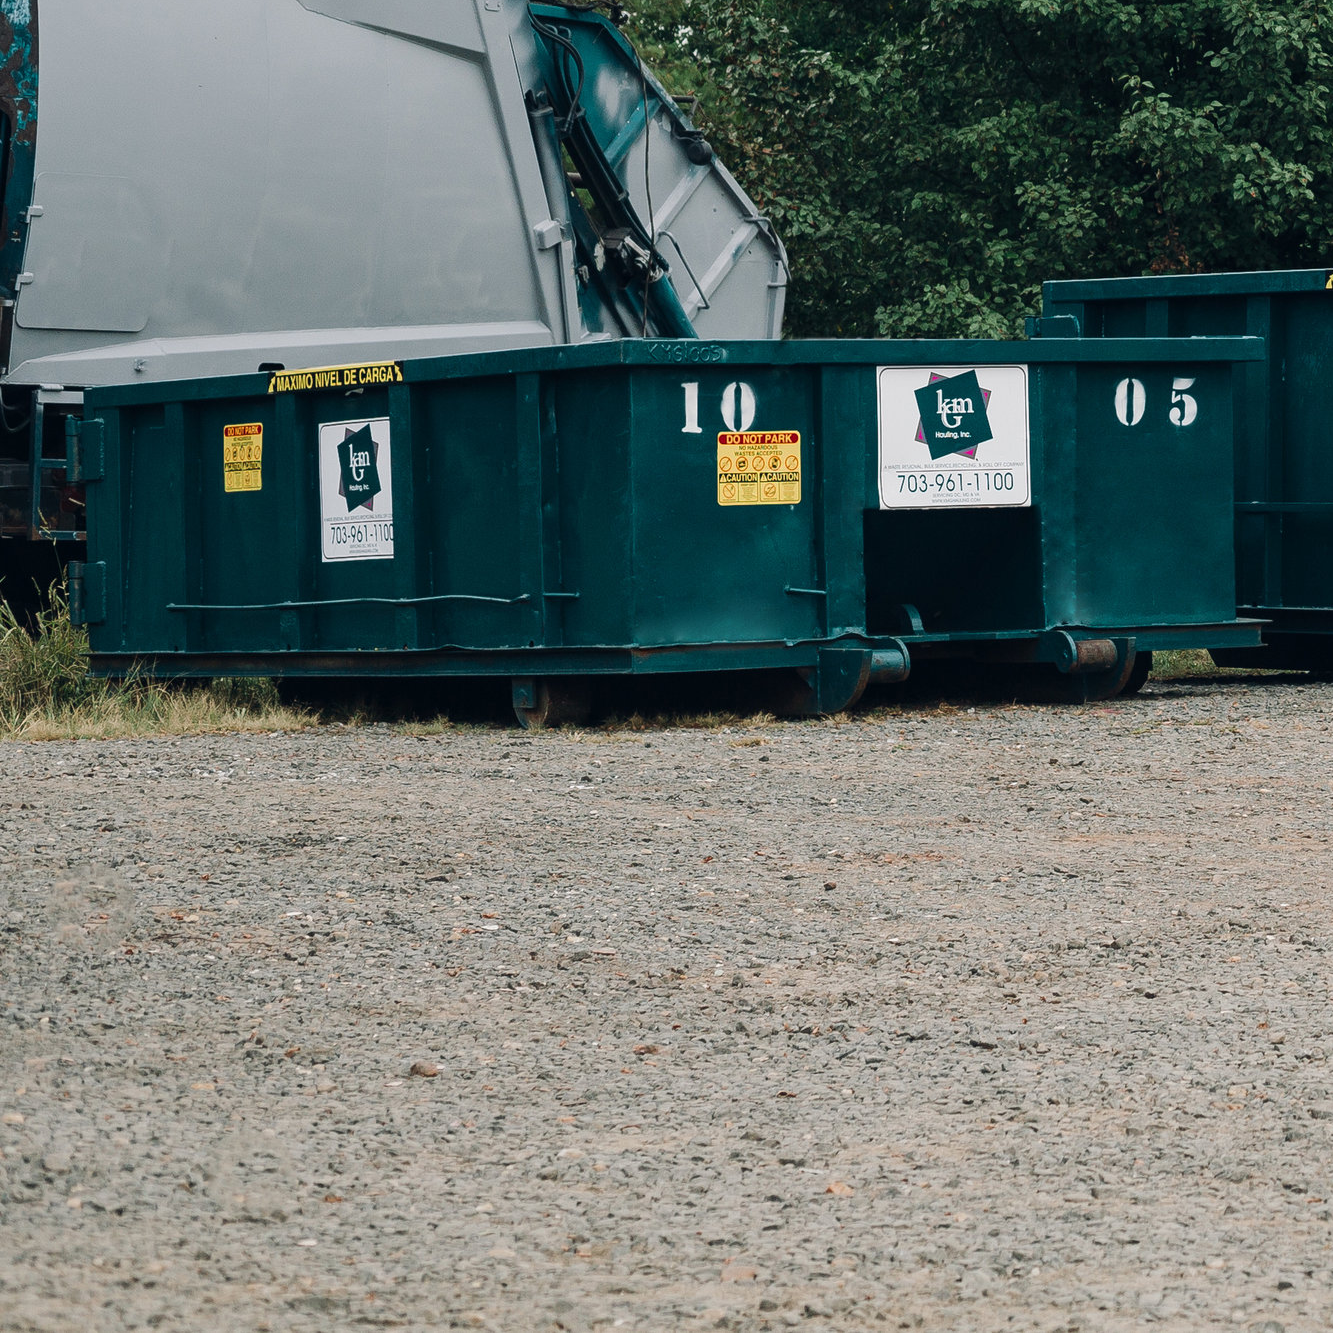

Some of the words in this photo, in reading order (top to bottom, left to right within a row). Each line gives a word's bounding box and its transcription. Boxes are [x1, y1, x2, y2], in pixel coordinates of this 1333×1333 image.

[277, 374, 313, 392] MAXIMO
[315, 371, 342, 387] NIVEL
[344, 369, 357, 385] DE
[359, 367, 394, 384] CARGA
[681, 382, 756, 433] 10
[235, 427, 244, 435] NOT
[245, 425, 259, 434] PARK
[726, 434, 740, 444] DO
[743, 434, 763, 443] NOT
[765, 434, 792, 443] PARK
[726, 473, 757, 482] CAUTION
[767, 473, 799, 481] CAUTION
[897, 472, 1014, 493] 703-961-1100
[331, 524, 394, 544] 703-961-1100
